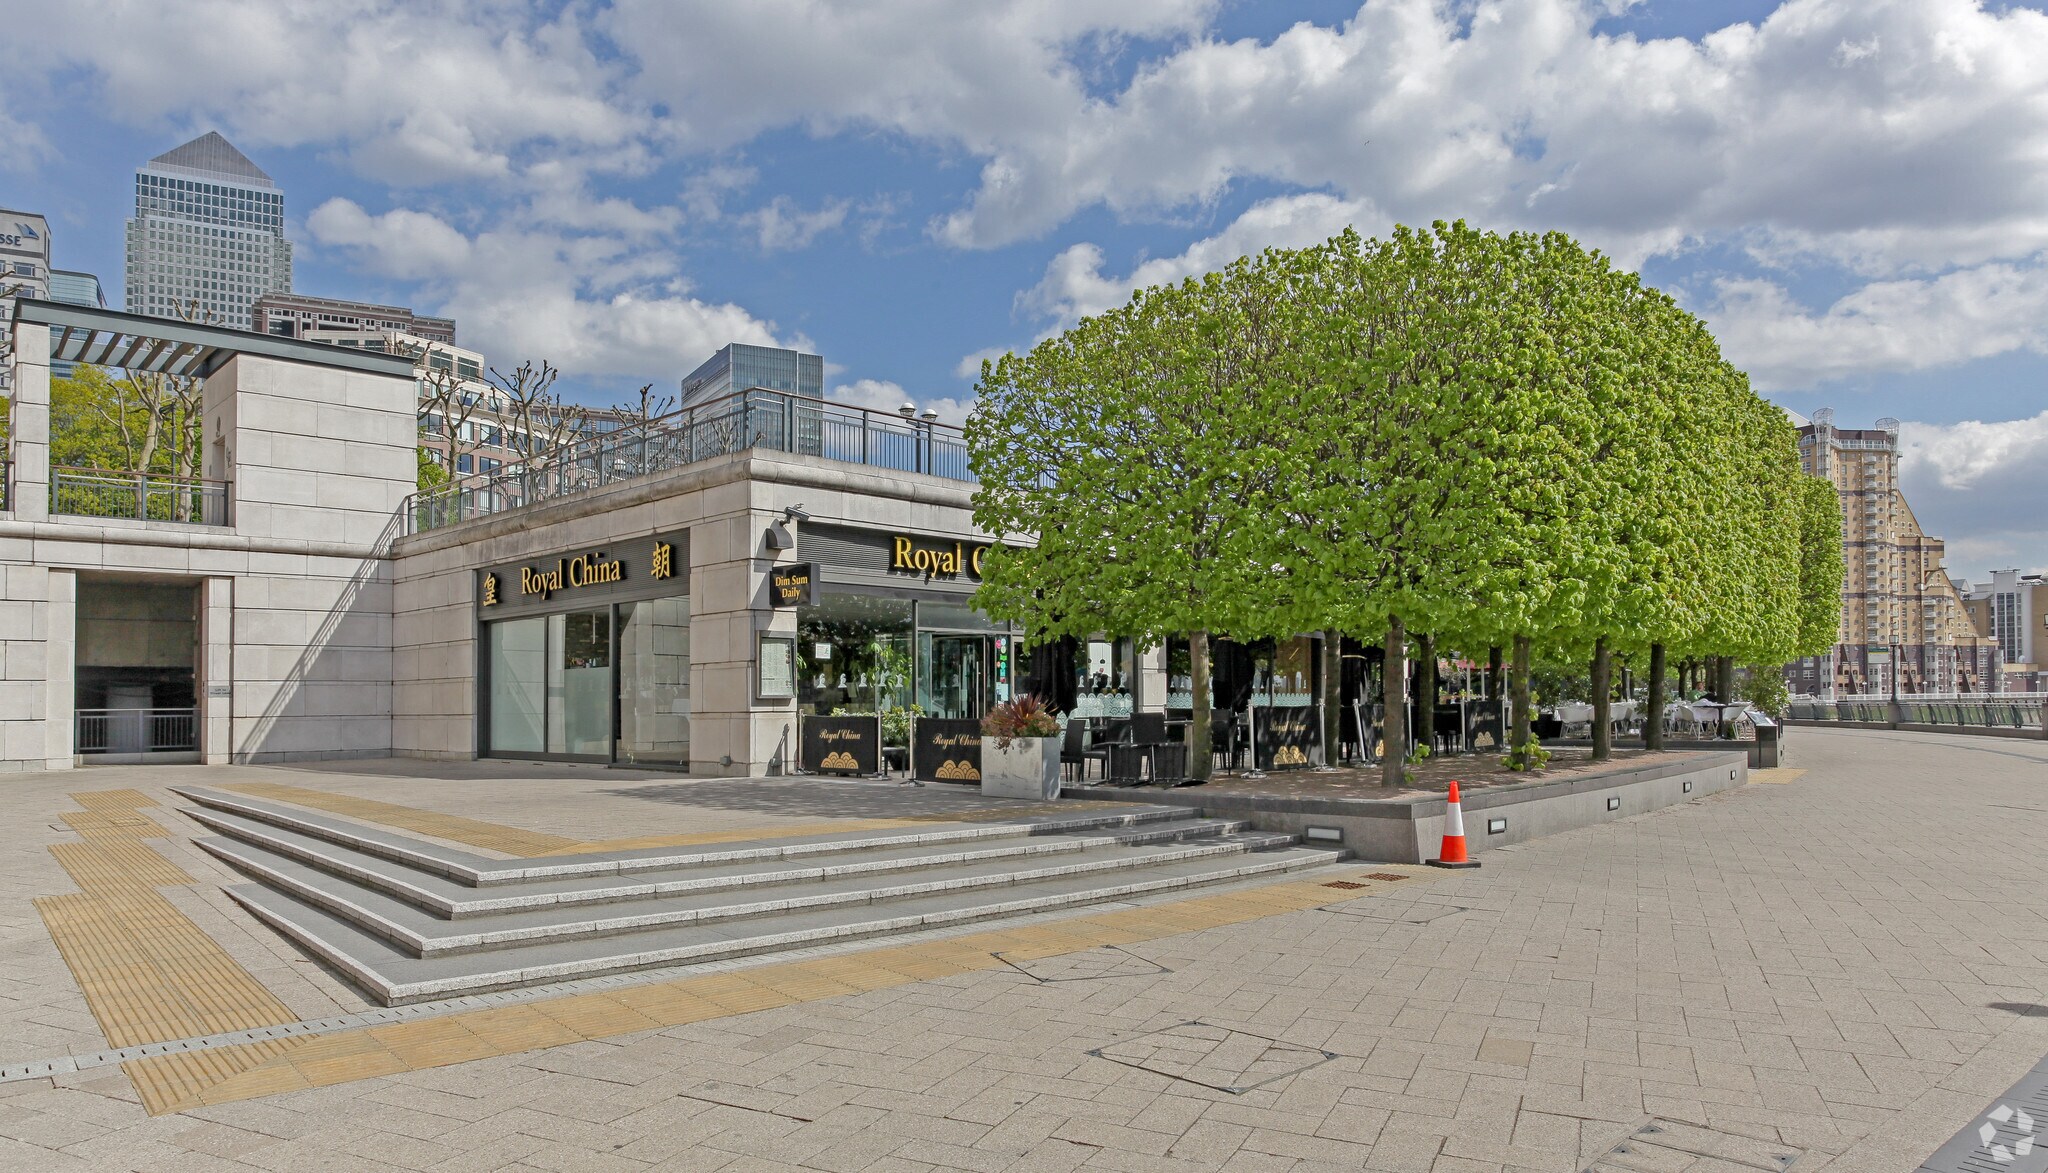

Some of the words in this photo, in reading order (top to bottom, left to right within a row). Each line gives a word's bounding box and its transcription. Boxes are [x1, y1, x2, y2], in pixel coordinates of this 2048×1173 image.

[651, 541, 671, 580] 朝
[894, 536, 962, 578] Royal
[521, 559, 563, 600] Royal
[570, 552, 621, 587] China
[775, 576, 790, 586] Dim
[791, 575, 808, 585] Sum
[483, 572, 497, 606] 皇
[781, 587, 800, 600] Daily
[819, 729, 840, 743] Royal
[841, 729, 861, 739] China
[933, 733, 958, 750] Royal
